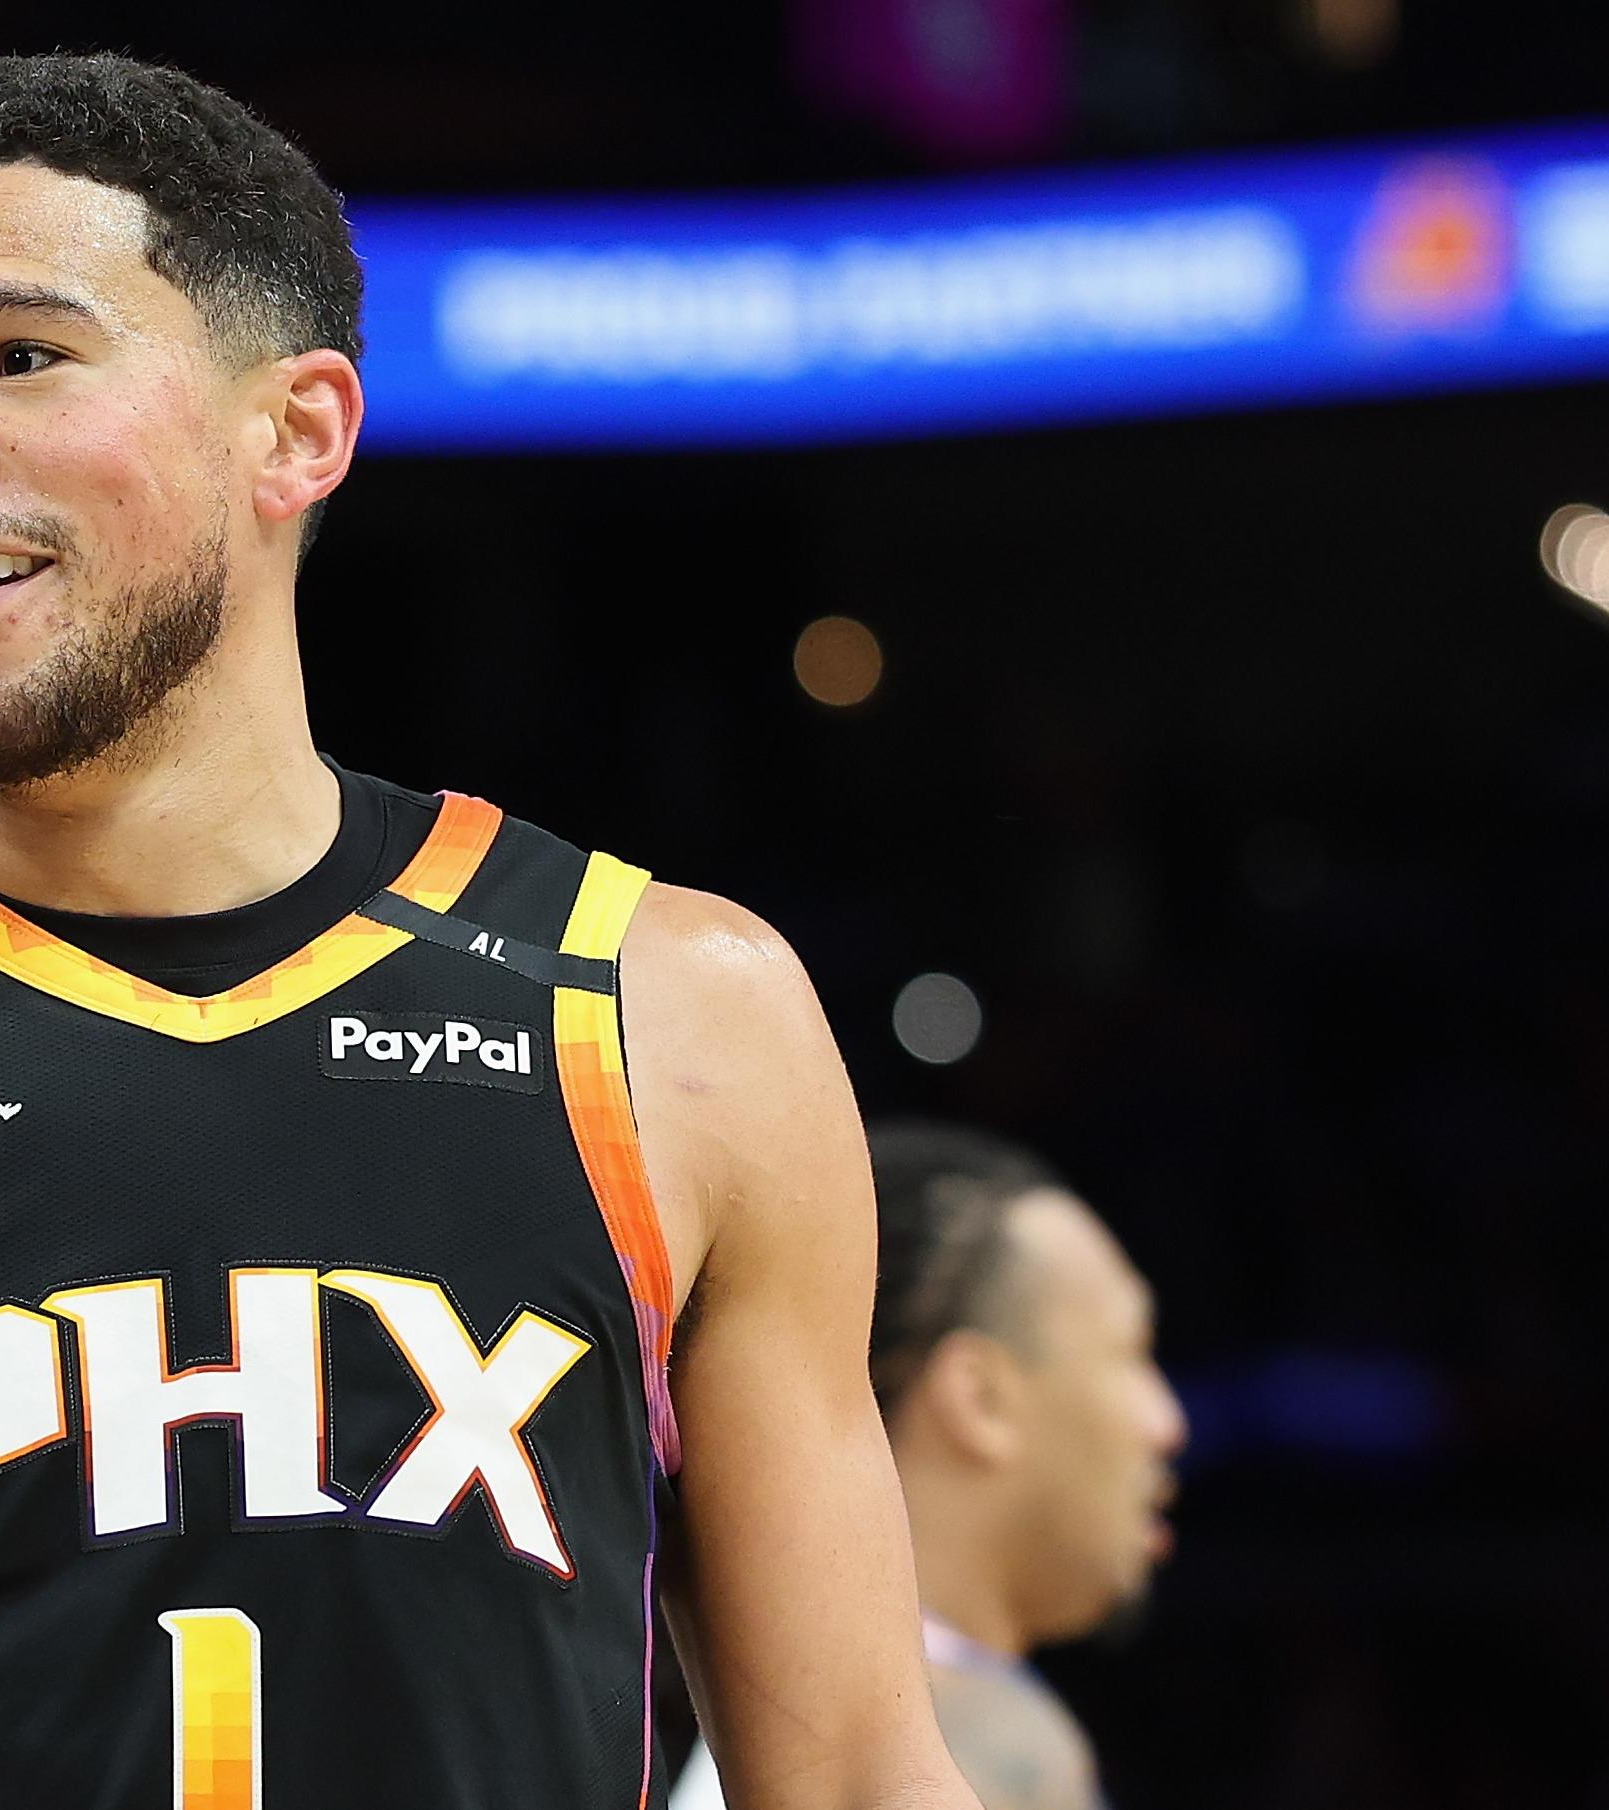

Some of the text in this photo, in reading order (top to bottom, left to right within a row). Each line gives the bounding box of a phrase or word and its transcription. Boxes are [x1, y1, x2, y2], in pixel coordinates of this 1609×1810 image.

[468, 931, 506, 962] AL
[330, 1017, 531, 1075] PayPal
[158, 1607, 263, 1810] 1
